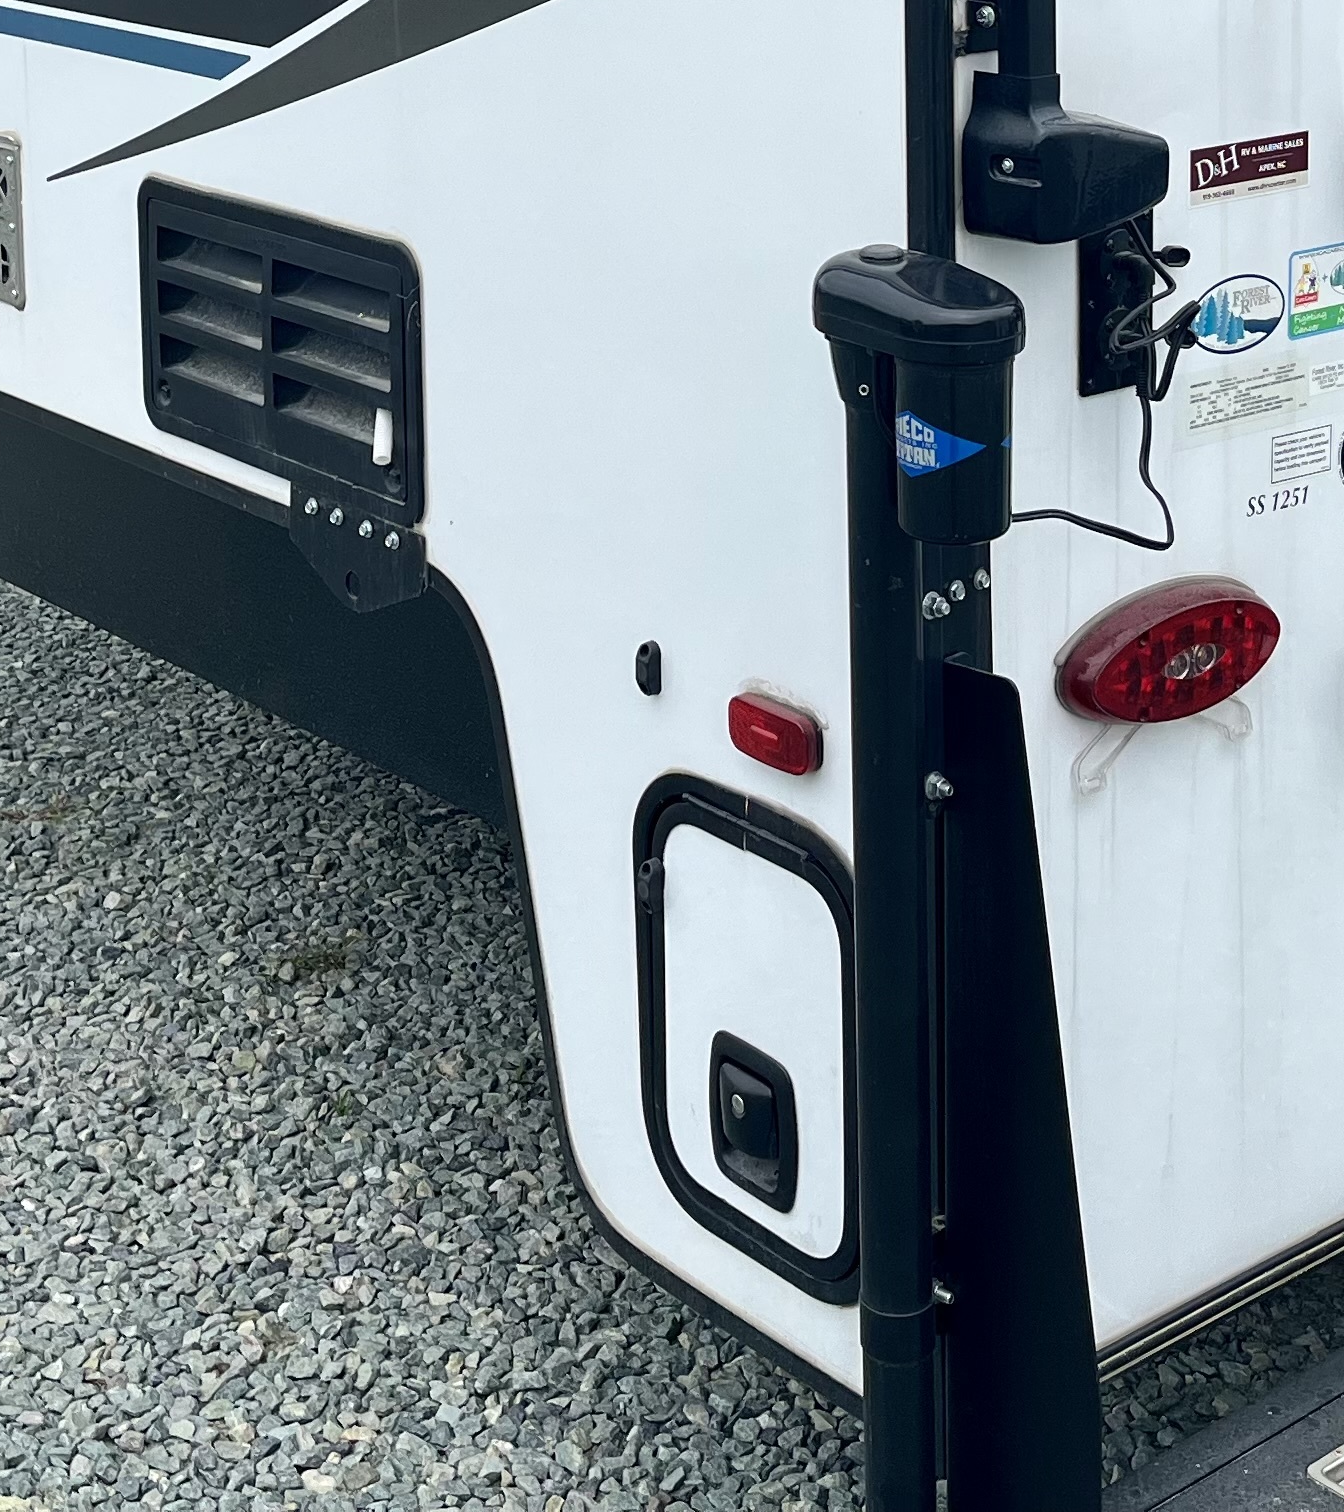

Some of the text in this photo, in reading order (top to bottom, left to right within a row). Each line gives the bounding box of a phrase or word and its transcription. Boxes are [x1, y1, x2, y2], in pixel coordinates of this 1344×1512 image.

[1258, 142, 1284, 153] MARINE
[1284, 138, 1304, 149] SALES
[1195, 144, 1240, 188] D&H
[1233, 285, 1271, 307] FOREST
[1240, 294, 1271, 315] RIVER
[1246, 485, 1309, 517] SS 1251
